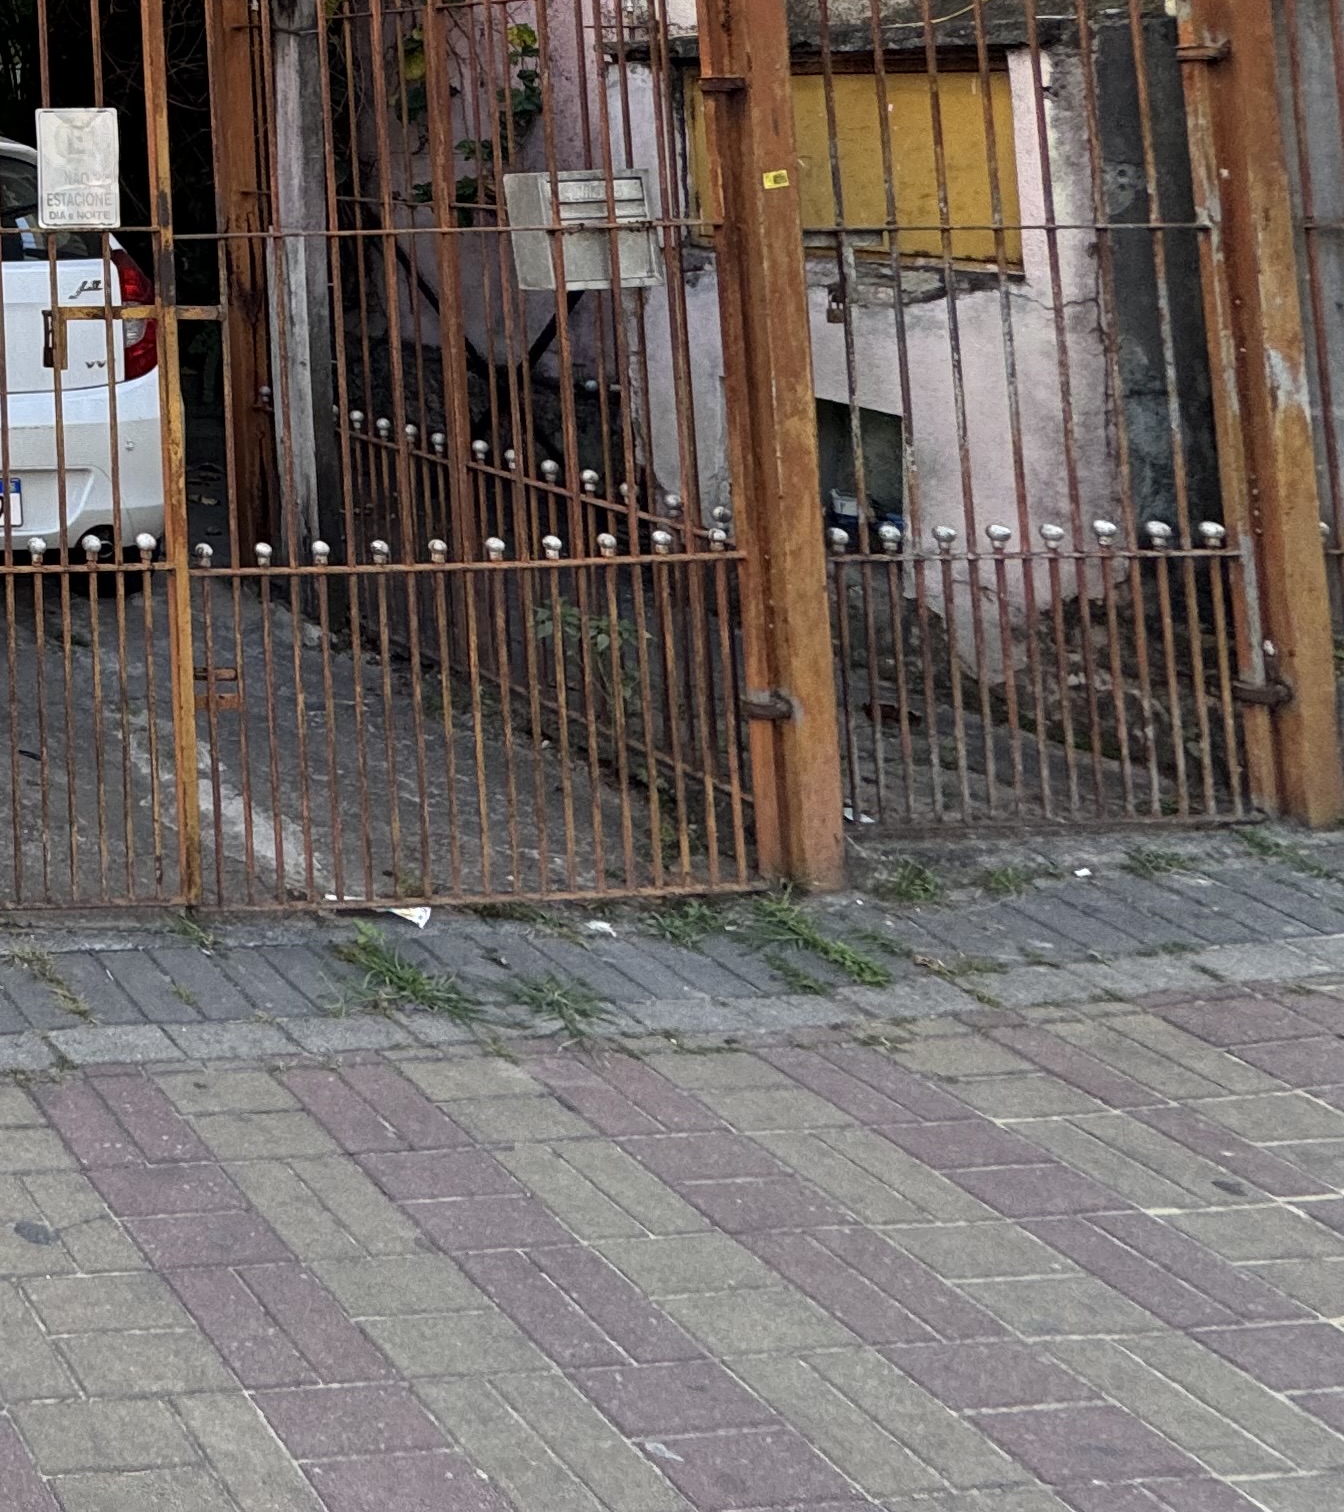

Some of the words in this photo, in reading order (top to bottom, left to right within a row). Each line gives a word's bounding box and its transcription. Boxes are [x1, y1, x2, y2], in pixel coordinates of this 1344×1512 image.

[46, 191, 113, 207] ESTACIONE
[48, 210, 66, 220] DIA
[76, 210, 111, 220] NOITE
